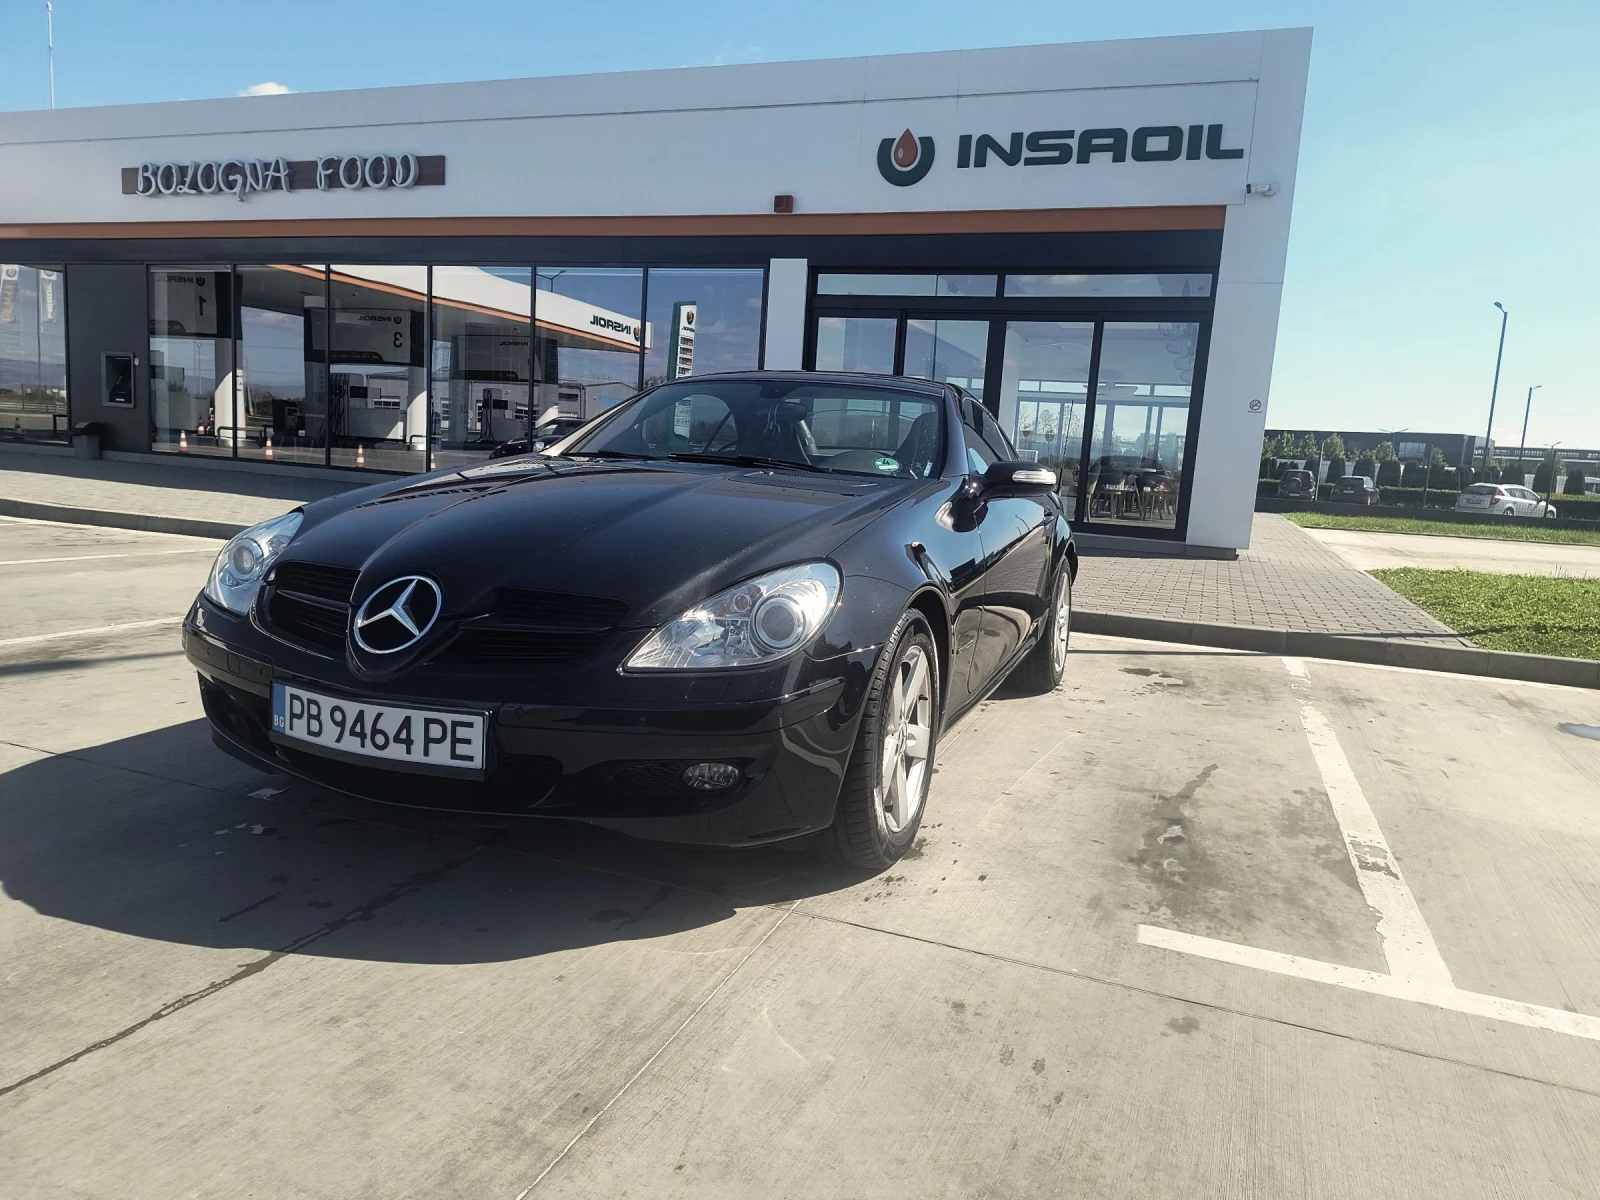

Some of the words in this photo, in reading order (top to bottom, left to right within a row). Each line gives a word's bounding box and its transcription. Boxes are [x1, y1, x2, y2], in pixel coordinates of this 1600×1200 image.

[956, 123, 1244, 169] INSAOIL
[136, 156, 292, 203] BOLOGNA
[316, 152, 420, 192] FOOD
[273, 714, 285, 728] BG
[289, 693, 323, 738] PB
[329, 704, 414, 755] 9464
[423, 717, 474, 763] PE
